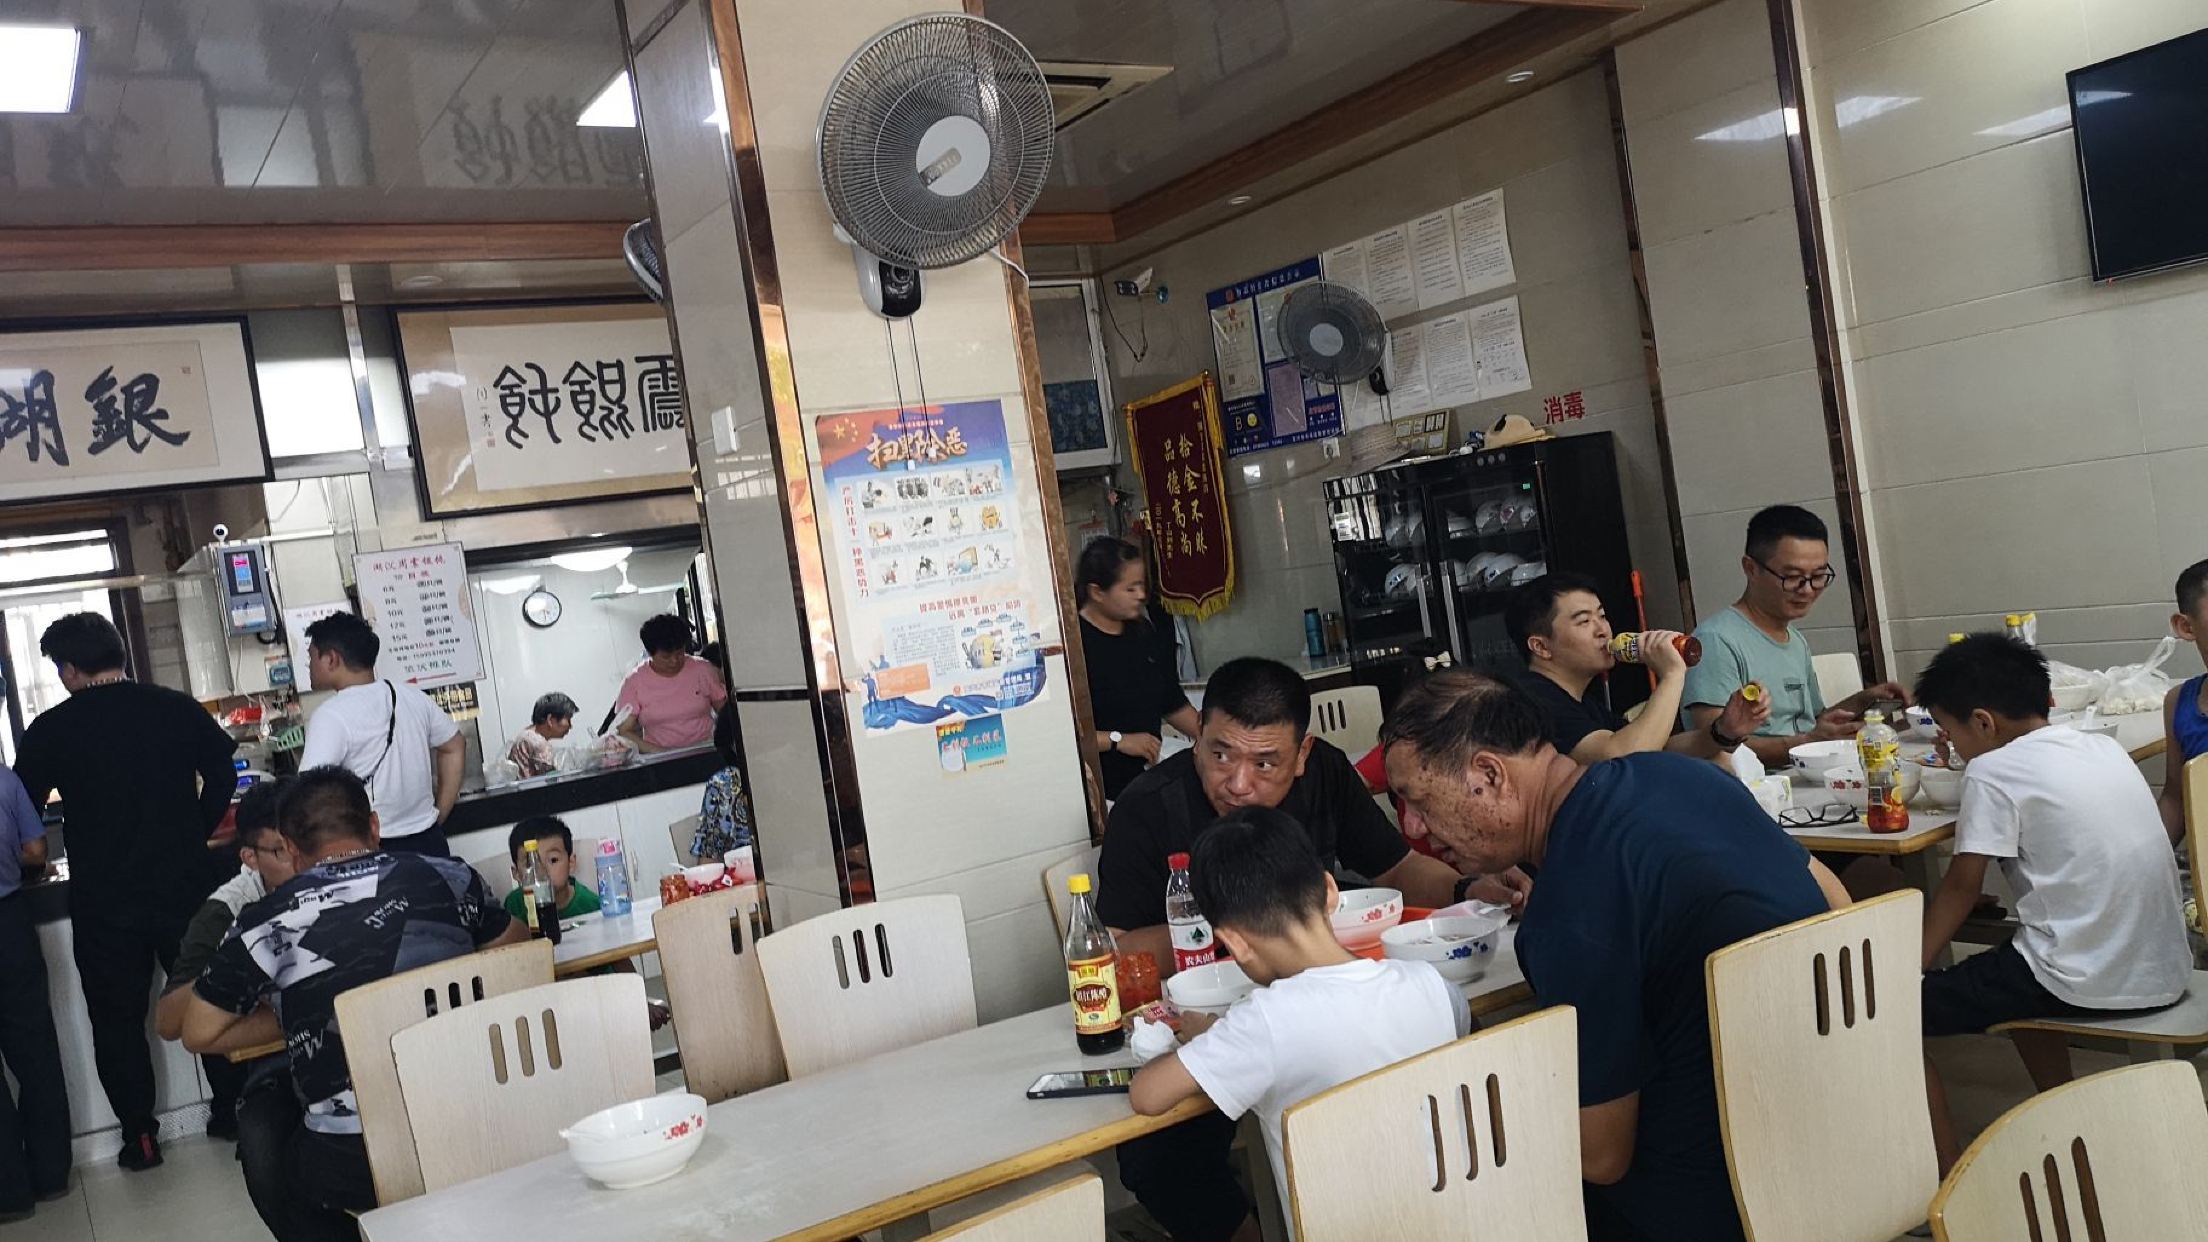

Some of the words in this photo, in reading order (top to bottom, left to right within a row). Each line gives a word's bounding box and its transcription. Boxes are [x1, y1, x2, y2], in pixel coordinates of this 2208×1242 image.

[866, 426, 968, 470] 扫黑除恶
[1544, 391, 1586, 425] 消毒
[1163, 437, 1192, 558] 品德高尚
[1178, 432, 1208, 556] 拾金不昧
